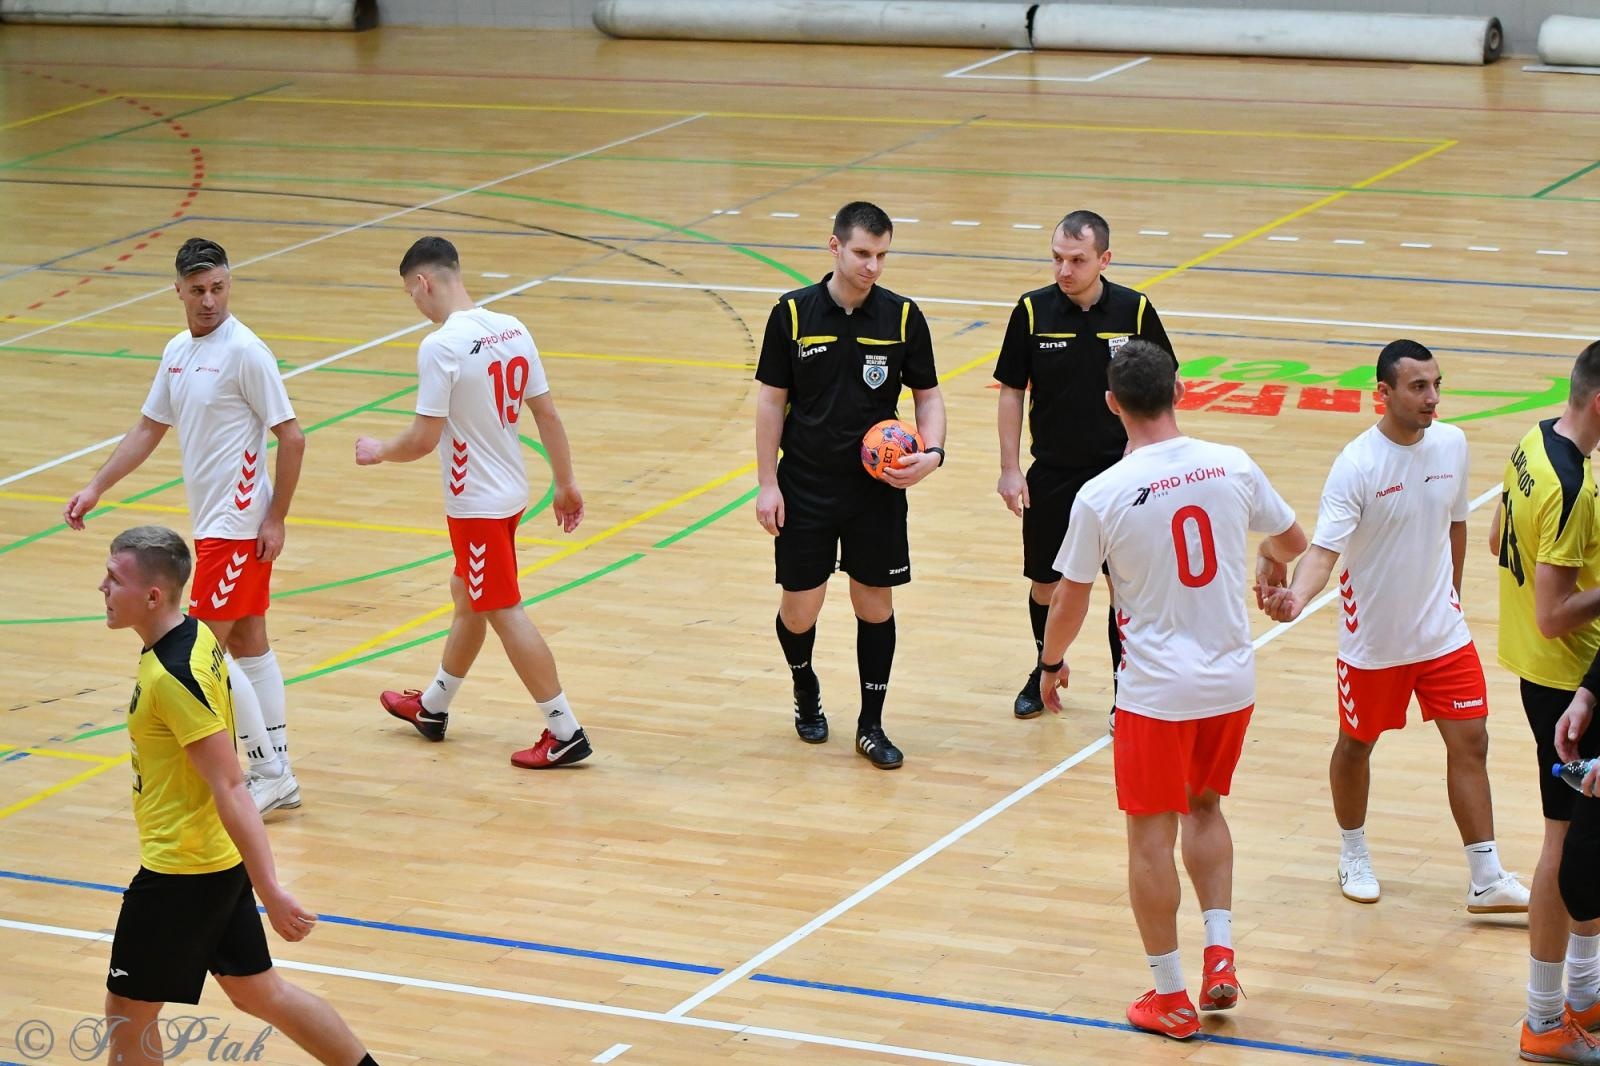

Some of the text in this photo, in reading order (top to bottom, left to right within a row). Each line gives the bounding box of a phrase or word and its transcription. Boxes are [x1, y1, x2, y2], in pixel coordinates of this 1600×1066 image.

[1039, 341, 1068, 349] zina
[487, 355, 529, 430] 19
[882, 446, 894, 464] ECT
[1150, 466, 1227, 494] PRD KÜHN
[1171, 505, 1218, 589] 0
[1453, 696, 1484, 710] hummel
